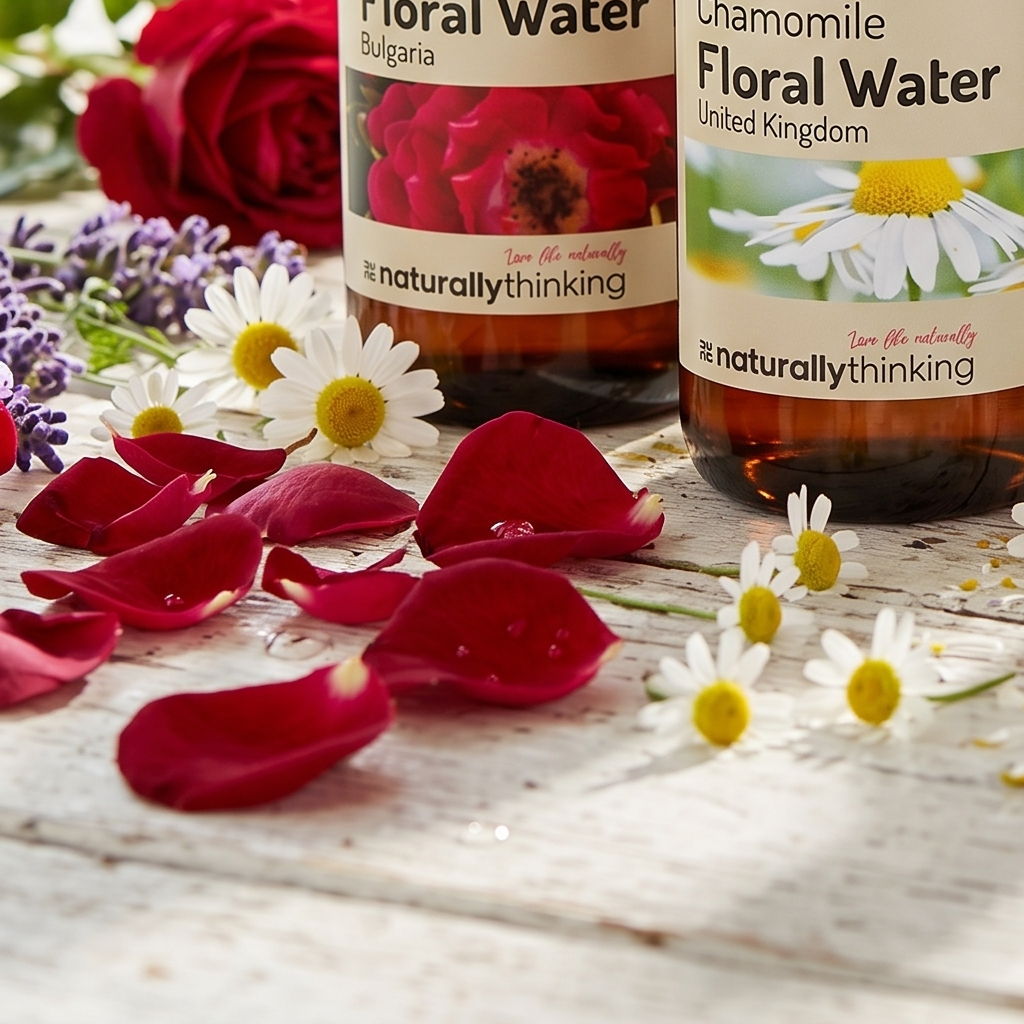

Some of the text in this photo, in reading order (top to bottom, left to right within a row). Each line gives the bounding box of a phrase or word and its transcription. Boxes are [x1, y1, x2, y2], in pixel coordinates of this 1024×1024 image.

[362, 29, 434, 68] Bulgaria
[699, 41, 1000, 108] Floral Water
[699, 97, 868, 148] United Kingdom
[378, 263, 625, 307] naturallythinking
[717, 344, 973, 390] naturallythinking
